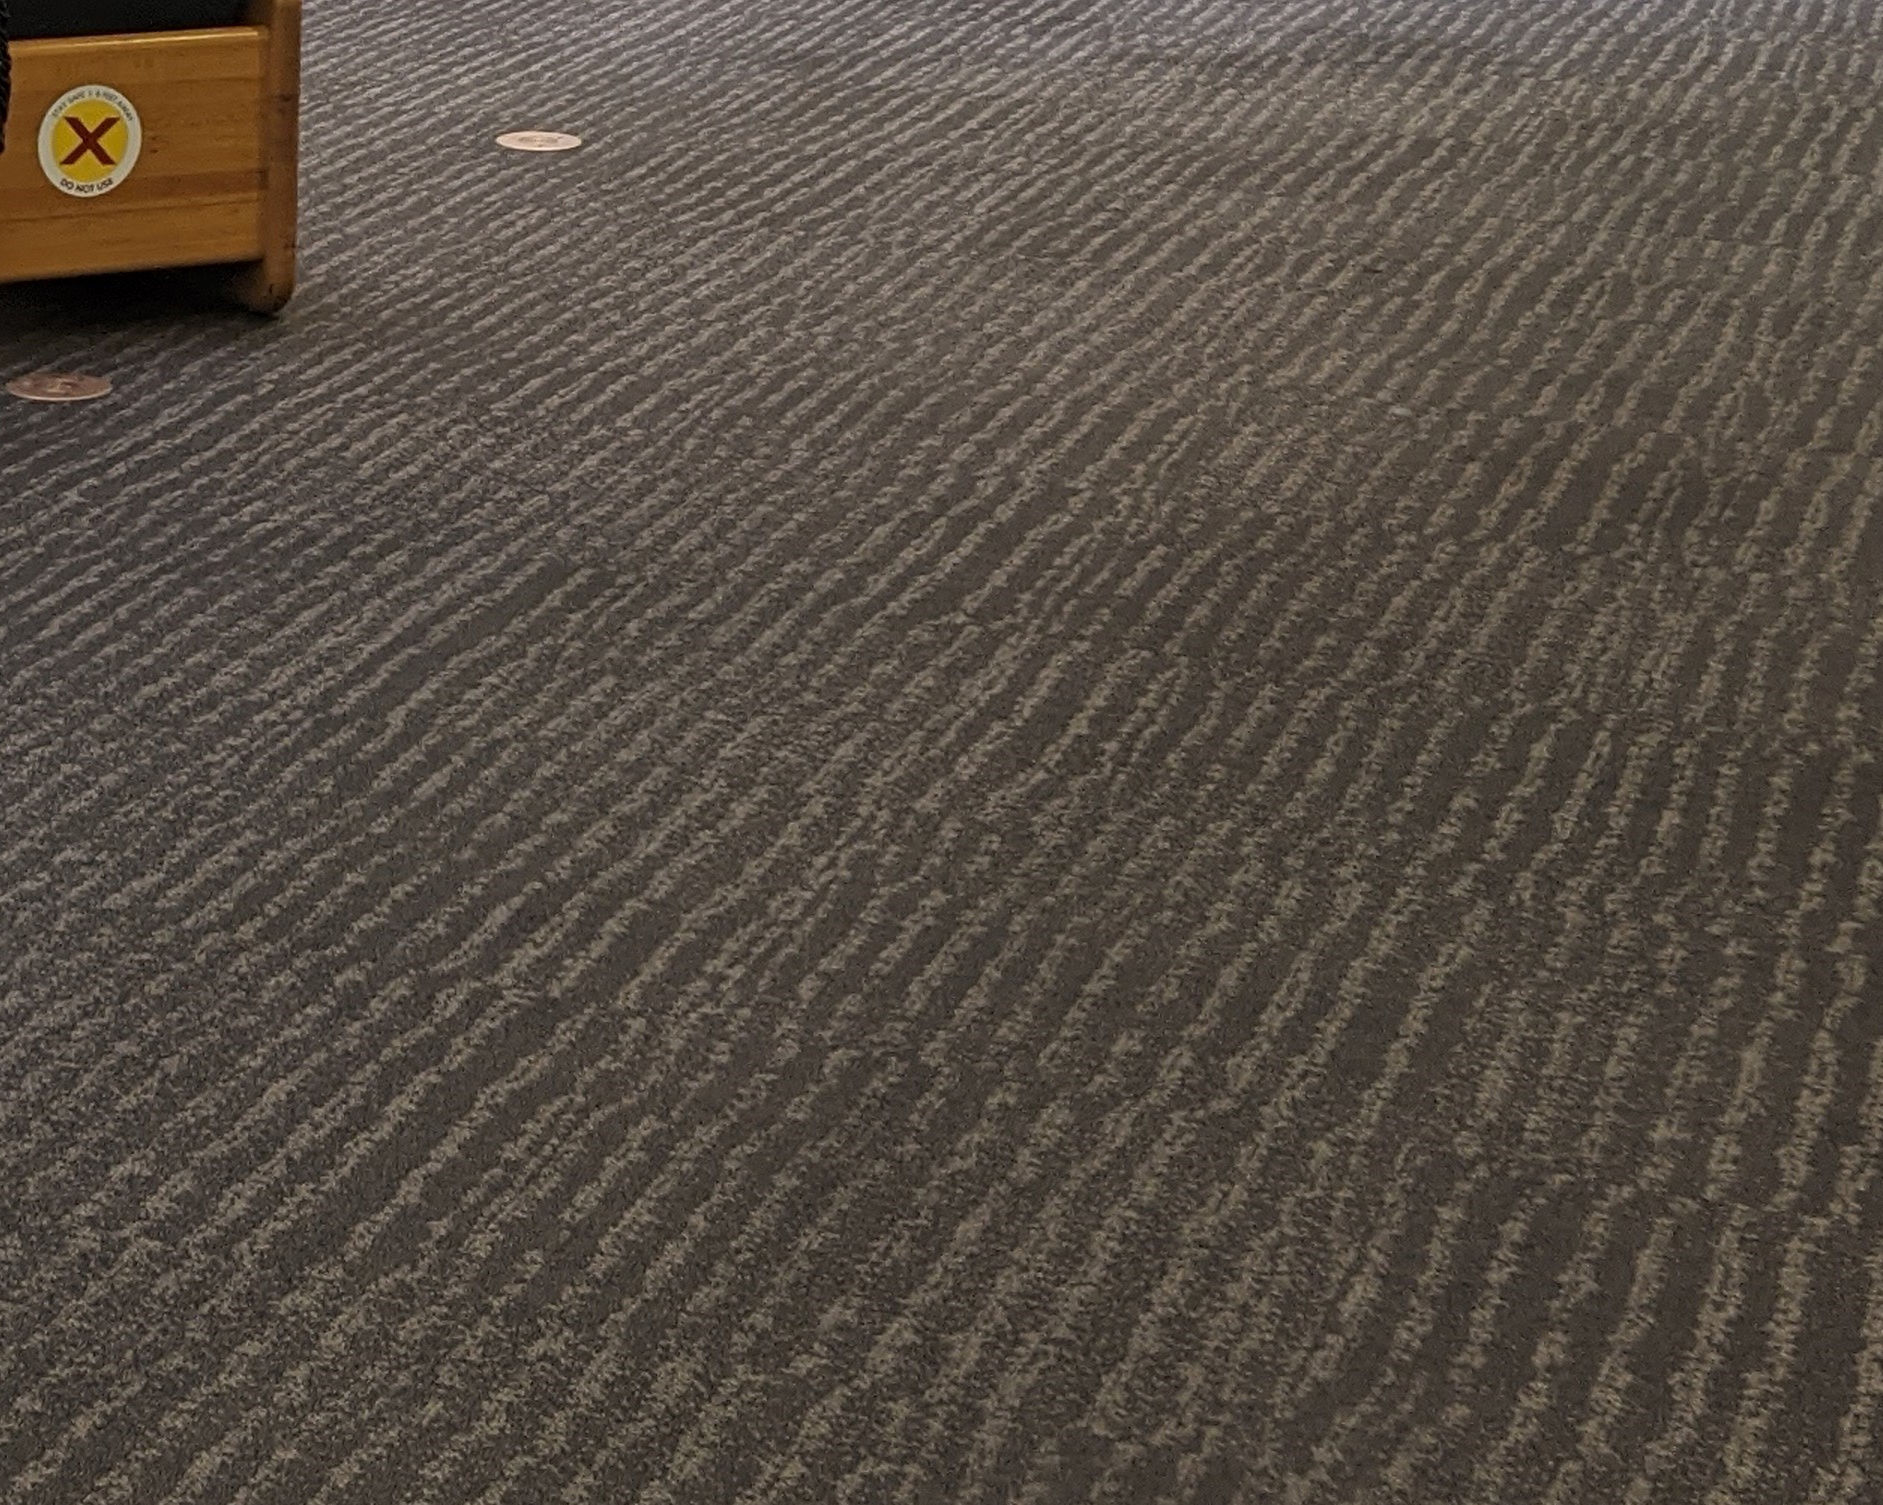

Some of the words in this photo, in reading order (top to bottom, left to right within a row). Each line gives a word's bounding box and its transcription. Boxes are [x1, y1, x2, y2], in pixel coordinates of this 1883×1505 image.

[60, 178, 74, 190] DO
[75, 184, 95, 194] NOT
[97, 178, 114, 191] USE
